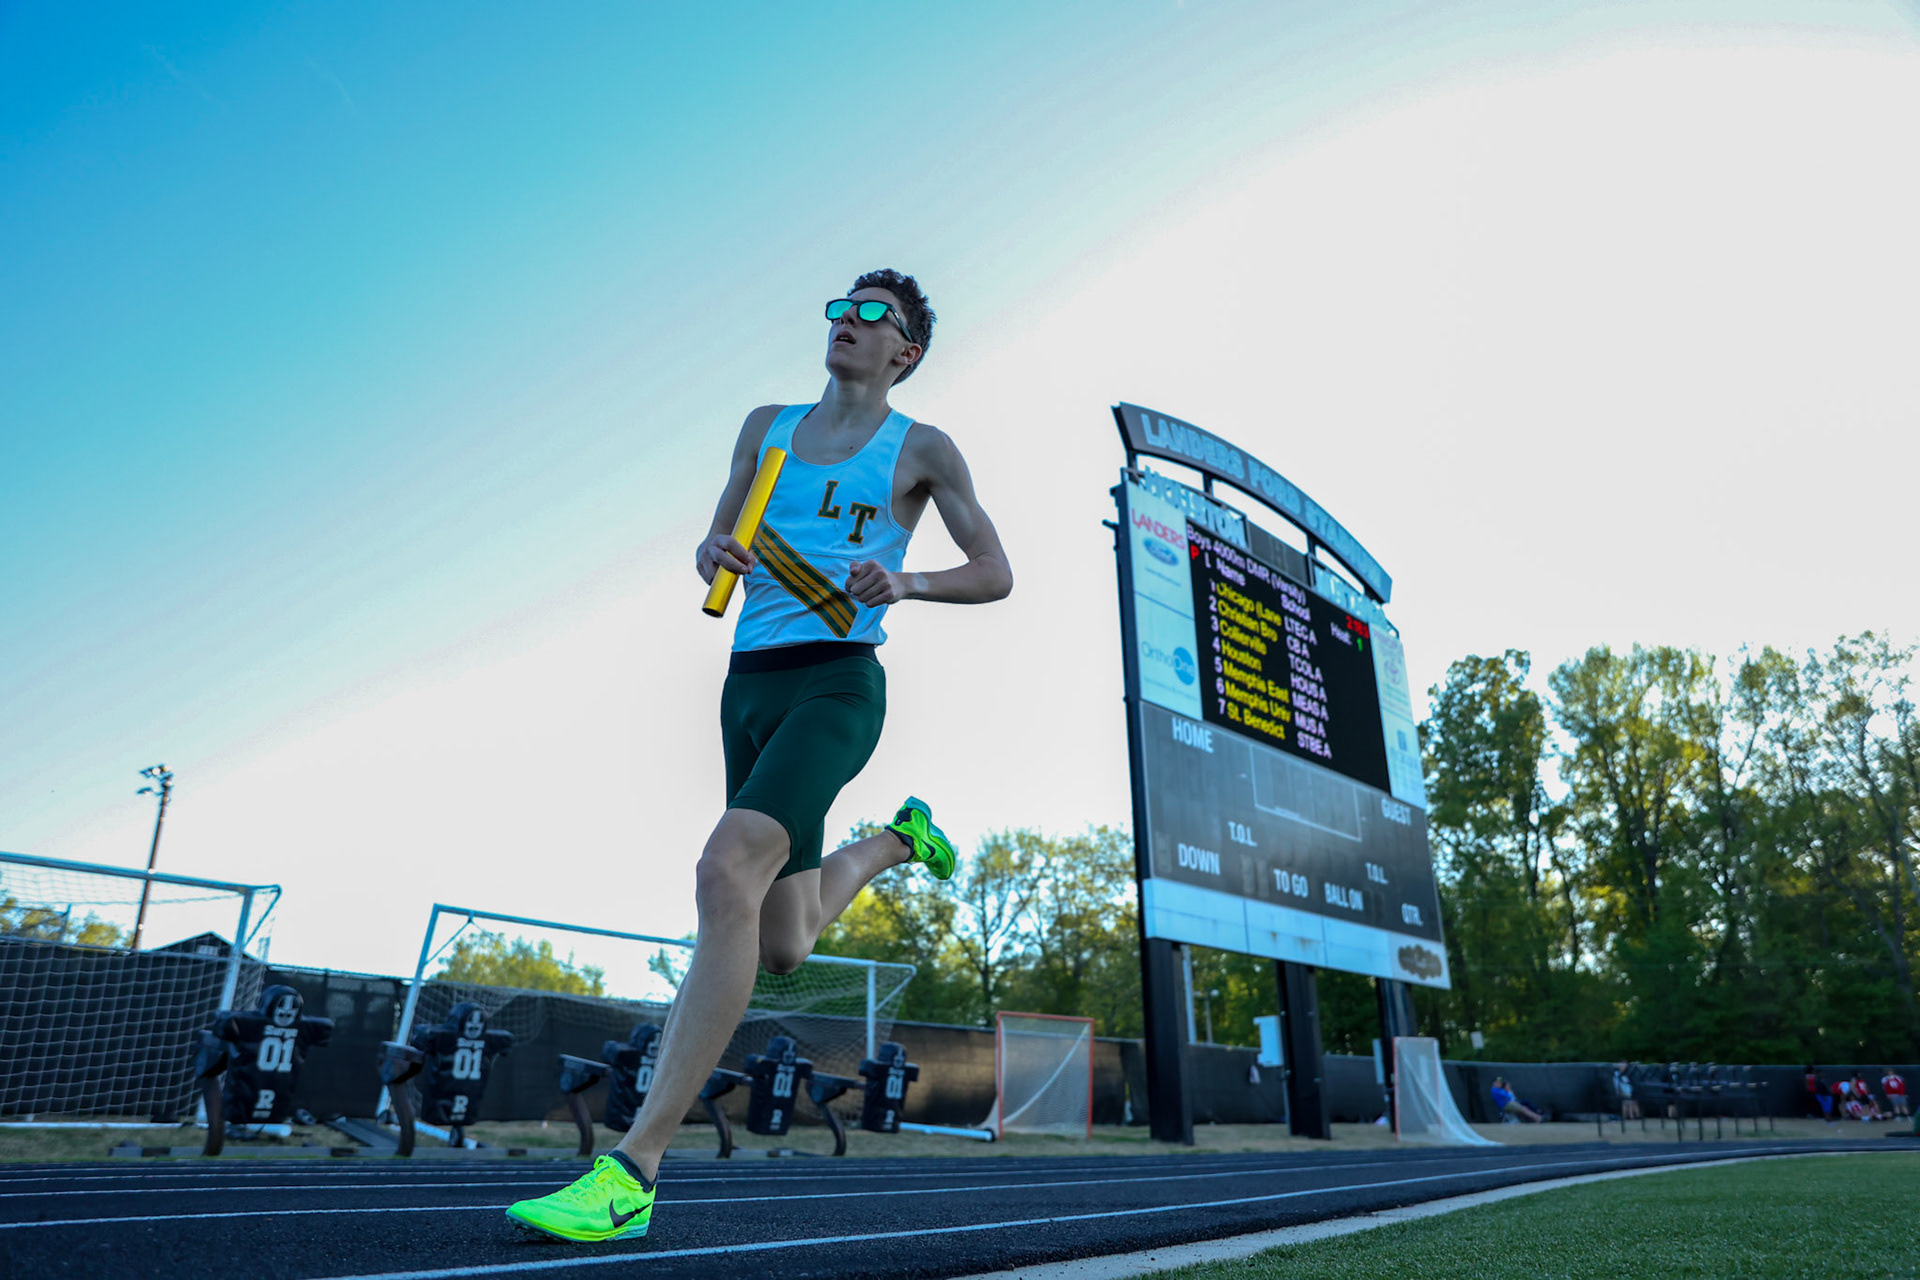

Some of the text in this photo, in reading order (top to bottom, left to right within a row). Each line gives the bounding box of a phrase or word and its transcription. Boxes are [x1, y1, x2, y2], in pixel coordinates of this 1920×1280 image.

[1141, 413, 1245, 479] LANDERS
[1248, 458, 1301, 515] FORD
[1131, 508, 1185, 550] LANDERS
[1187, 524, 1212, 551] Boys
[1213, 540, 1246, 569] 4000m
[1216, 557, 1246, 587] Name
[1281, 593, 1311, 622] School
[1216, 582, 1255, 612] Chicago
[1255, 601, 1282, 627] (Lane
[1209, 594, 1217, 612] 2
[1217, 600, 1260, 633] Christian
[1210, 614, 1219, 632] 3
[1220, 619, 1267, 656] Collierville
[1356, 638, 1363, 651] 1
[1212, 636, 1220, 653] 4
[1221, 639, 1262, 672] Houston
[1214, 655, 1223, 674] 5
[1223, 660, 1267, 694] Memphis
[1267, 680, 1290, 704] East
[1290, 672, 1319, 699] HOUS
[1216, 677, 1225, 695] 6
[1225, 680, 1269, 714] Memphis
[1269, 700, 1291, 722] Univ
[1172, 717, 1213, 753] HOME
[1217, 697, 1226, 715] 7
[1243, 708, 1286, 740] Benedict
[1294, 711, 1317, 735] MUS
[1381, 798, 1412, 826] GUEST
[1177, 844, 1220, 876] DOWN
[1273, 868, 1309, 898] TO GO
[1324, 882, 1363, 911] BALL ON
[262, 1024, 298, 1039] Surge
[256, 1036, 296, 1073] 01
[451, 1048, 483, 1080] 01
[255, 1089, 276, 1109] R
[772, 1072, 794, 1098] 01
[885, 1075, 903, 1099] 01
[452, 1095, 469, 1113] R
